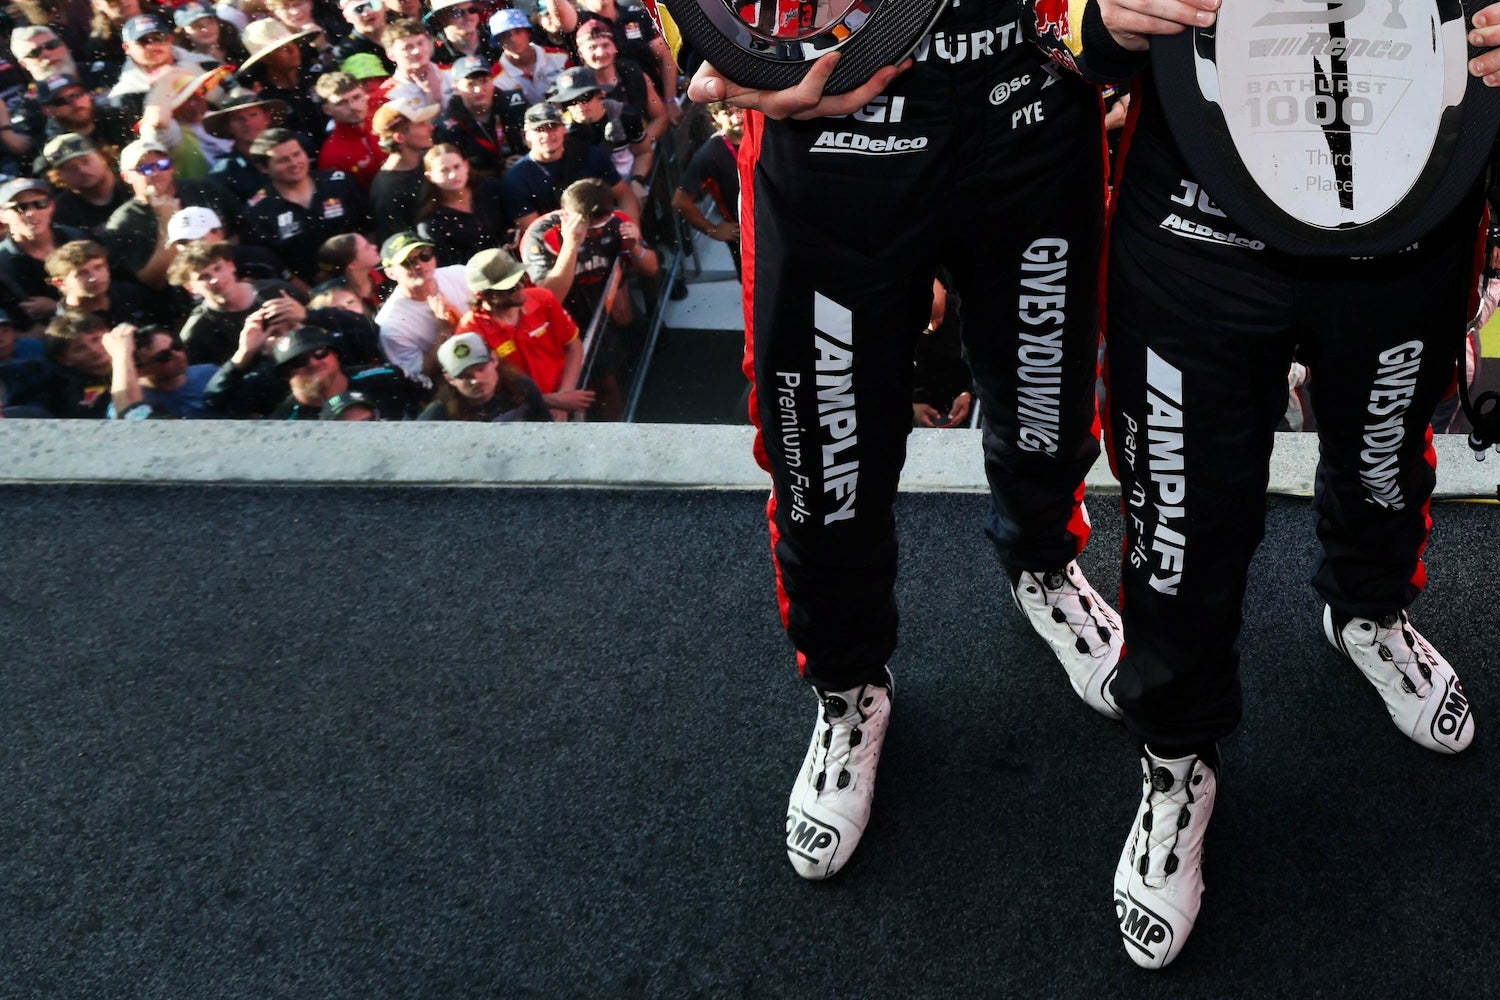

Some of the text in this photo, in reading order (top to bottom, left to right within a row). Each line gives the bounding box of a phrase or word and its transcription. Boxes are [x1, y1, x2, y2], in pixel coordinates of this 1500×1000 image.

[1295, 32, 1413, 61] Repco
[1246, 80, 1388, 95] BATHURST
[824, 96, 905, 124] GI
[1011, 101, 1045, 130] PYE
[1245, 95, 1374, 128] 1000
[814, 131, 929, 152] ACDelco
[1305, 149, 1353, 167] Third
[1305, 174, 1354, 192] Place
[1161, 213, 1266, 252] ACDelco
[1018, 238, 1068, 325] GIVES
[1017, 329, 1064, 384] YOU
[1367, 340, 1424, 416] GIVES
[776, 371, 811, 524] Premium Fuels
[814, 334, 860, 526] AMPLIFY
[1360, 410, 1407, 465] YOU
[1147, 391, 1188, 597] AMPLIFY
[1114, 898, 1167, 948] OMP
